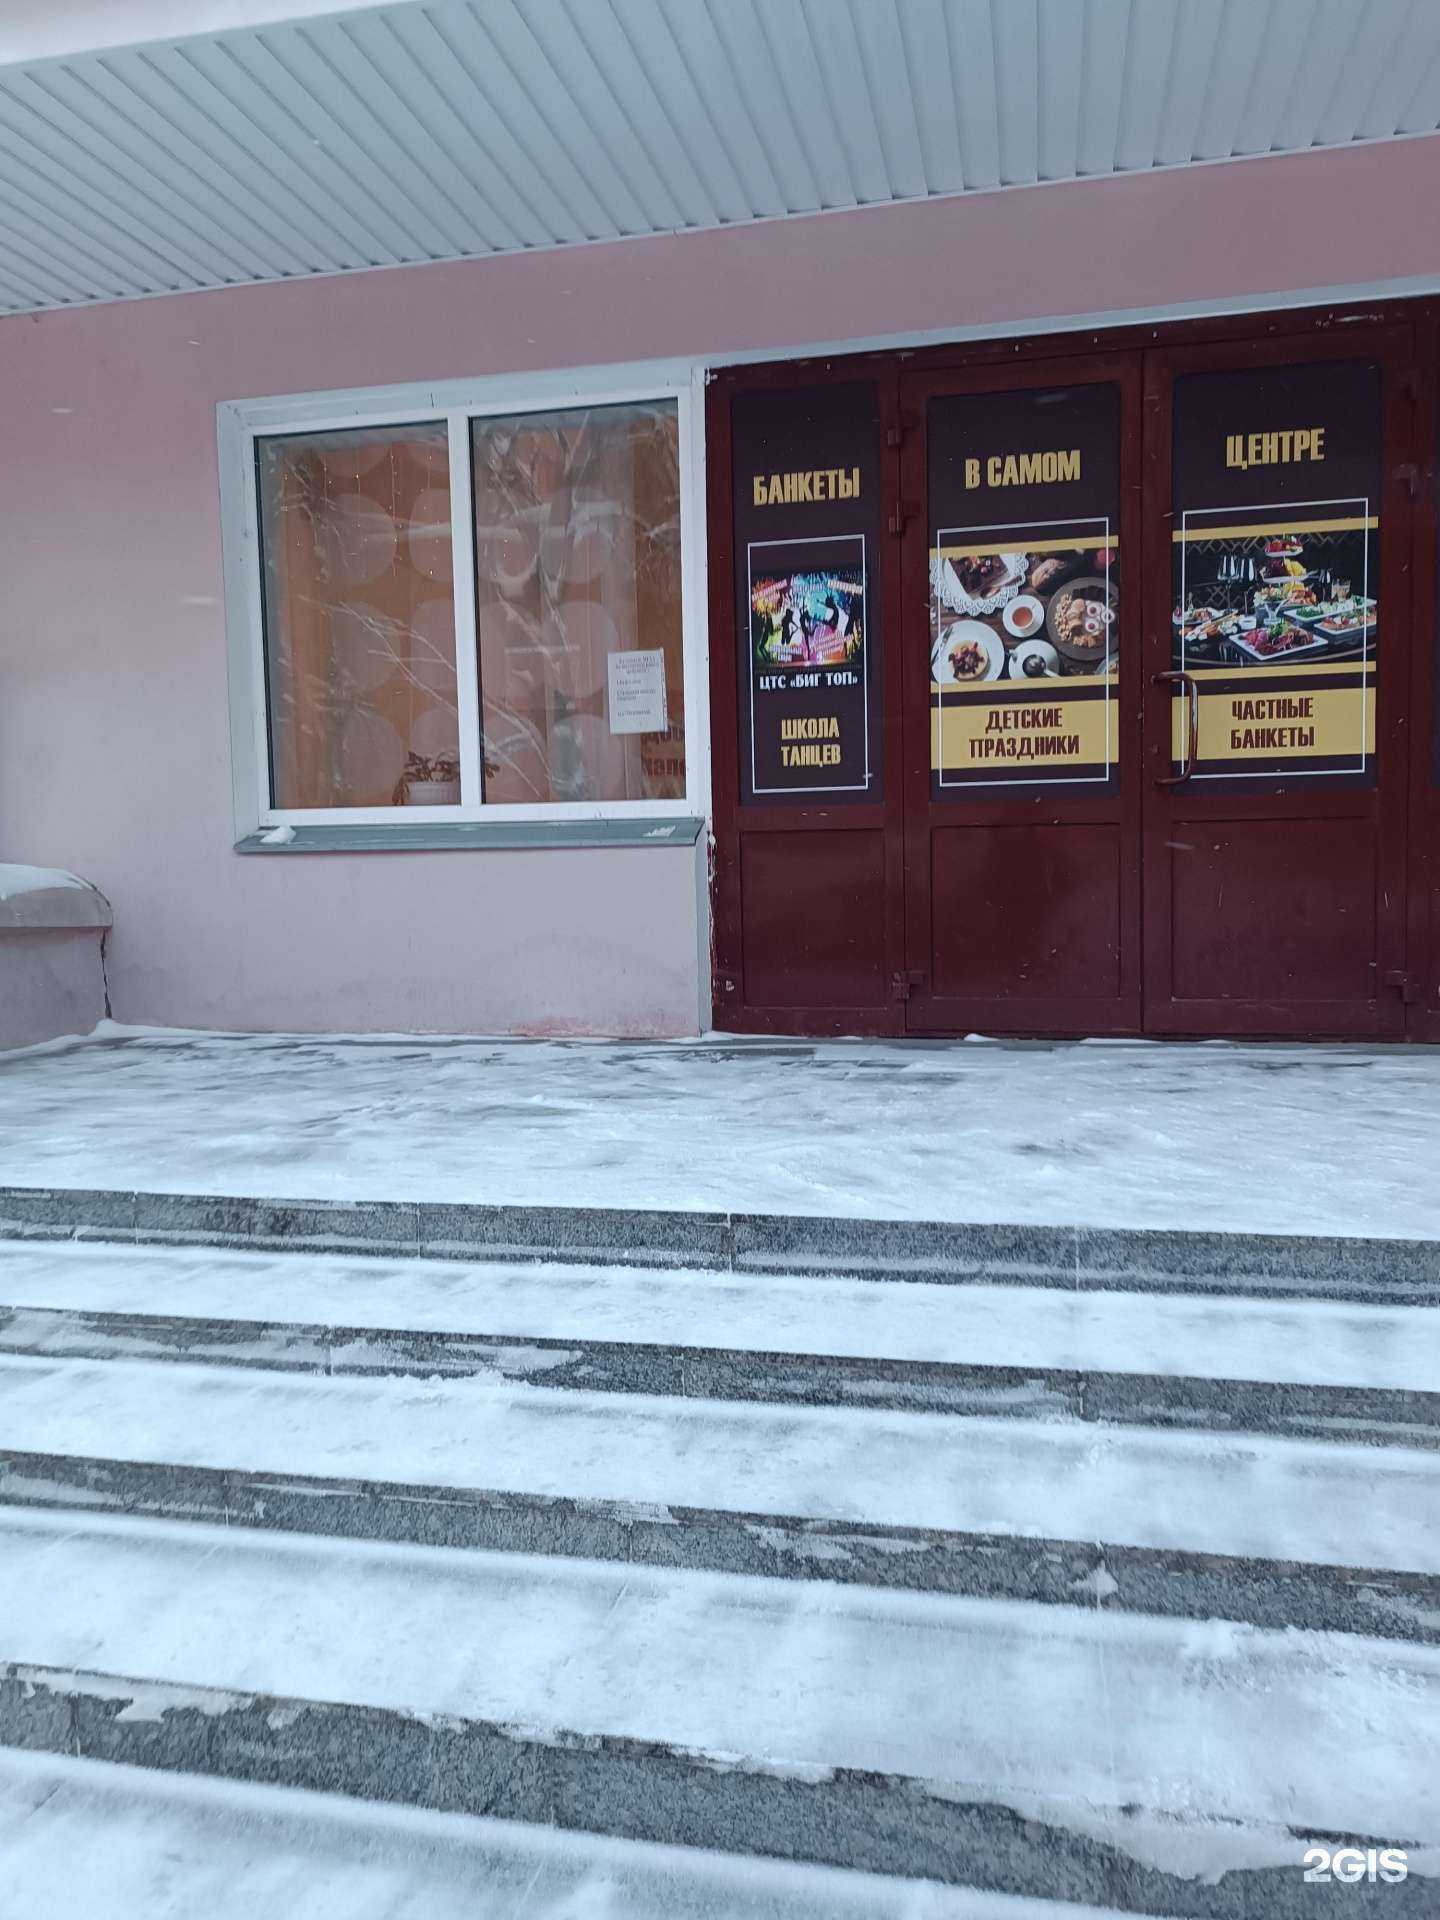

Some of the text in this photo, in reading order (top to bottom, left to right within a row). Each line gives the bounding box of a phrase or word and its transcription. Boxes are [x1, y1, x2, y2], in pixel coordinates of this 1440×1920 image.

[1226, 427, 1325, 470] ЦЕНТРЕ
[964, 450, 1081, 489] В САМОМ
[753, 467, 860, 506] БАНКЕТЫ
[760, 675, 786, 691] ЦТС
[985, 708, 1062, 733] ДЕТСКИЕ
[1231, 697, 1314, 720] ЧАСТНЫЕ
[781, 717, 840, 740] ШКОЛА
[1230, 726, 1315, 749] БАНКЕТЫ
[780, 744, 841, 767] ТАНЦЕВ
[969, 735, 1080, 760] ПРАЗДНИКИ
